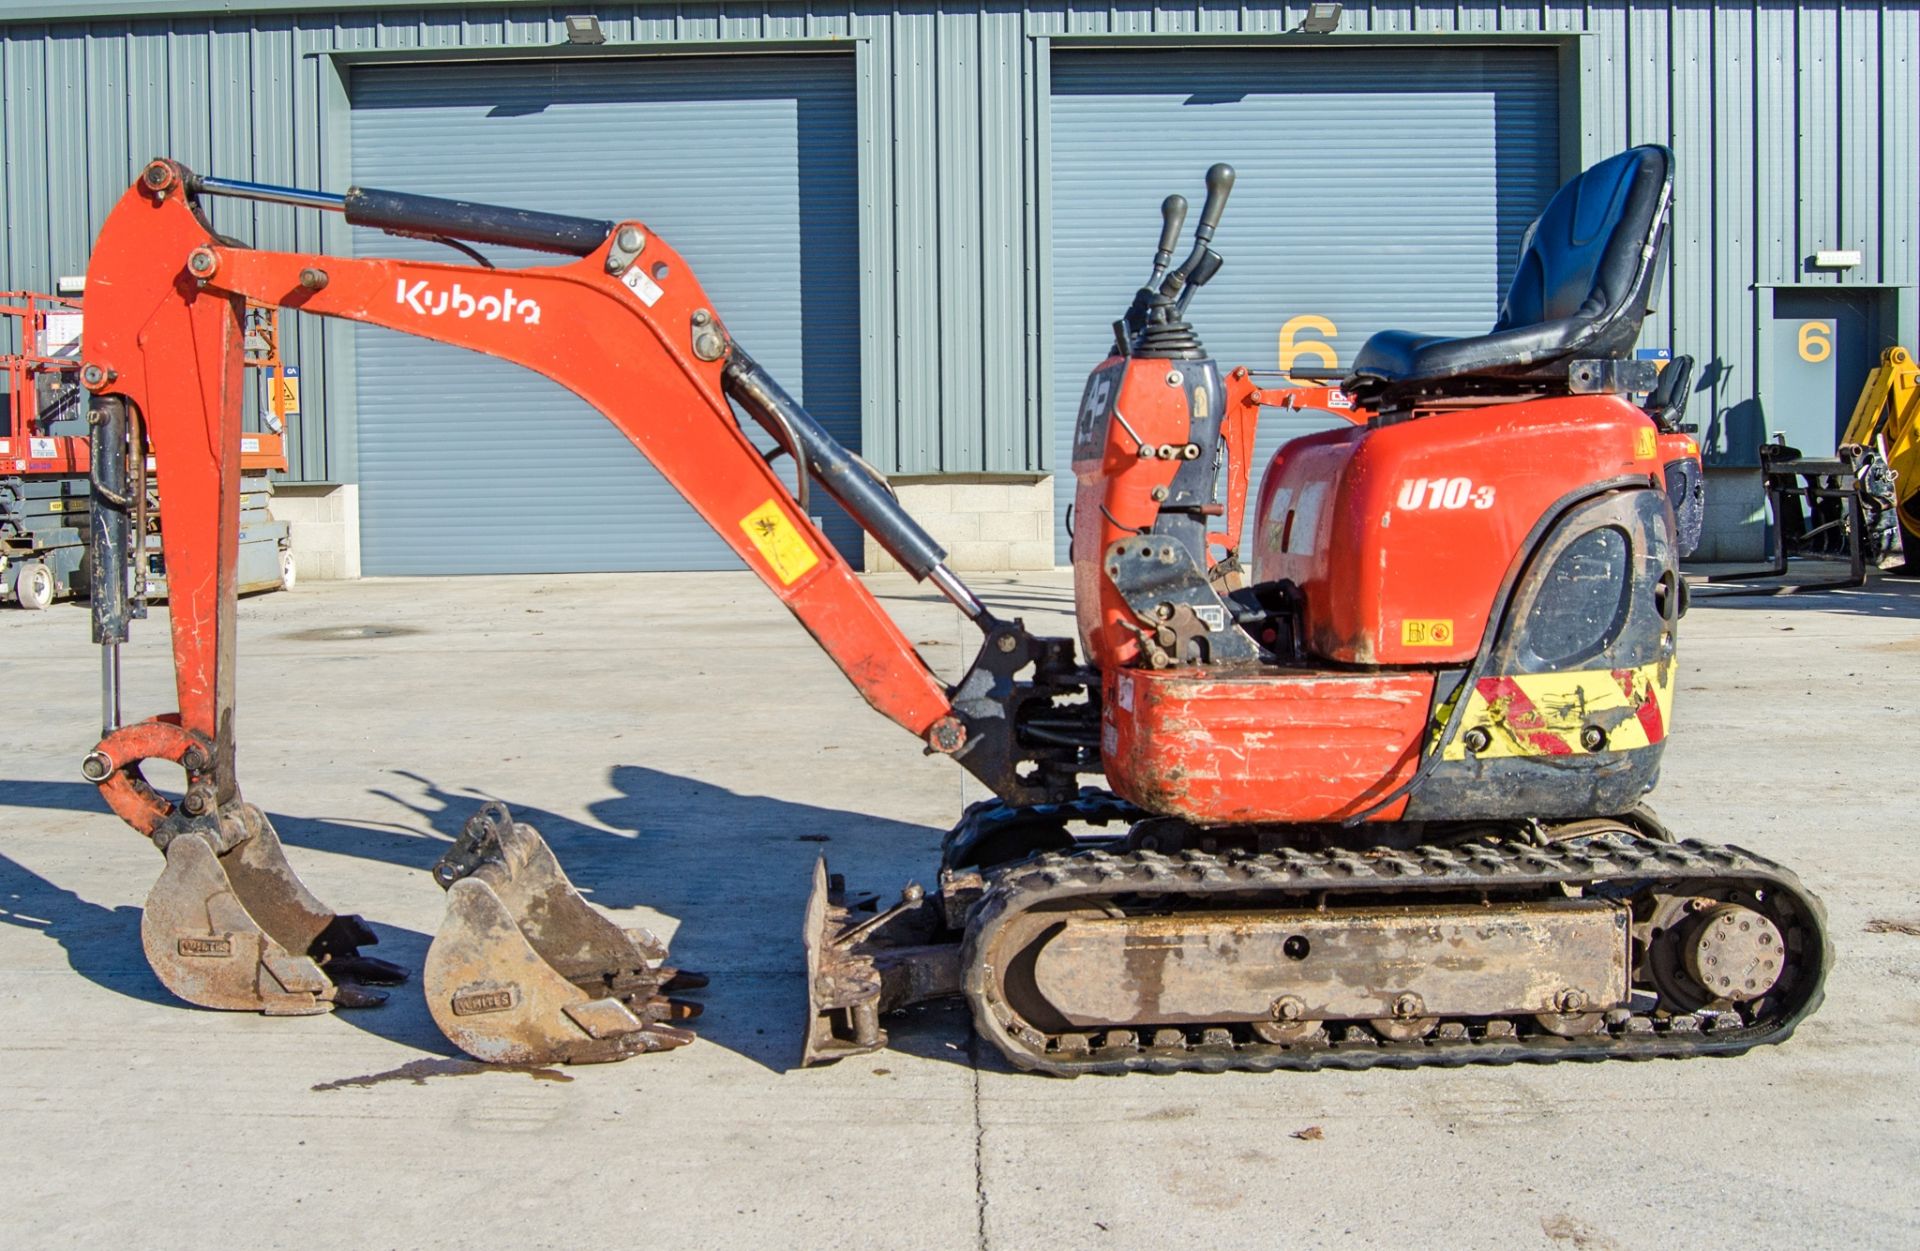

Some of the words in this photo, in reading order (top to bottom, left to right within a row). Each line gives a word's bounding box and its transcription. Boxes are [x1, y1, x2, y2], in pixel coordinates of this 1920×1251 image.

[396, 278, 541, 325] Kubota
[1279, 314, 1338, 387] 6
[1798, 321, 1832, 363] 6
[1396, 477, 1497, 511] U10-3
